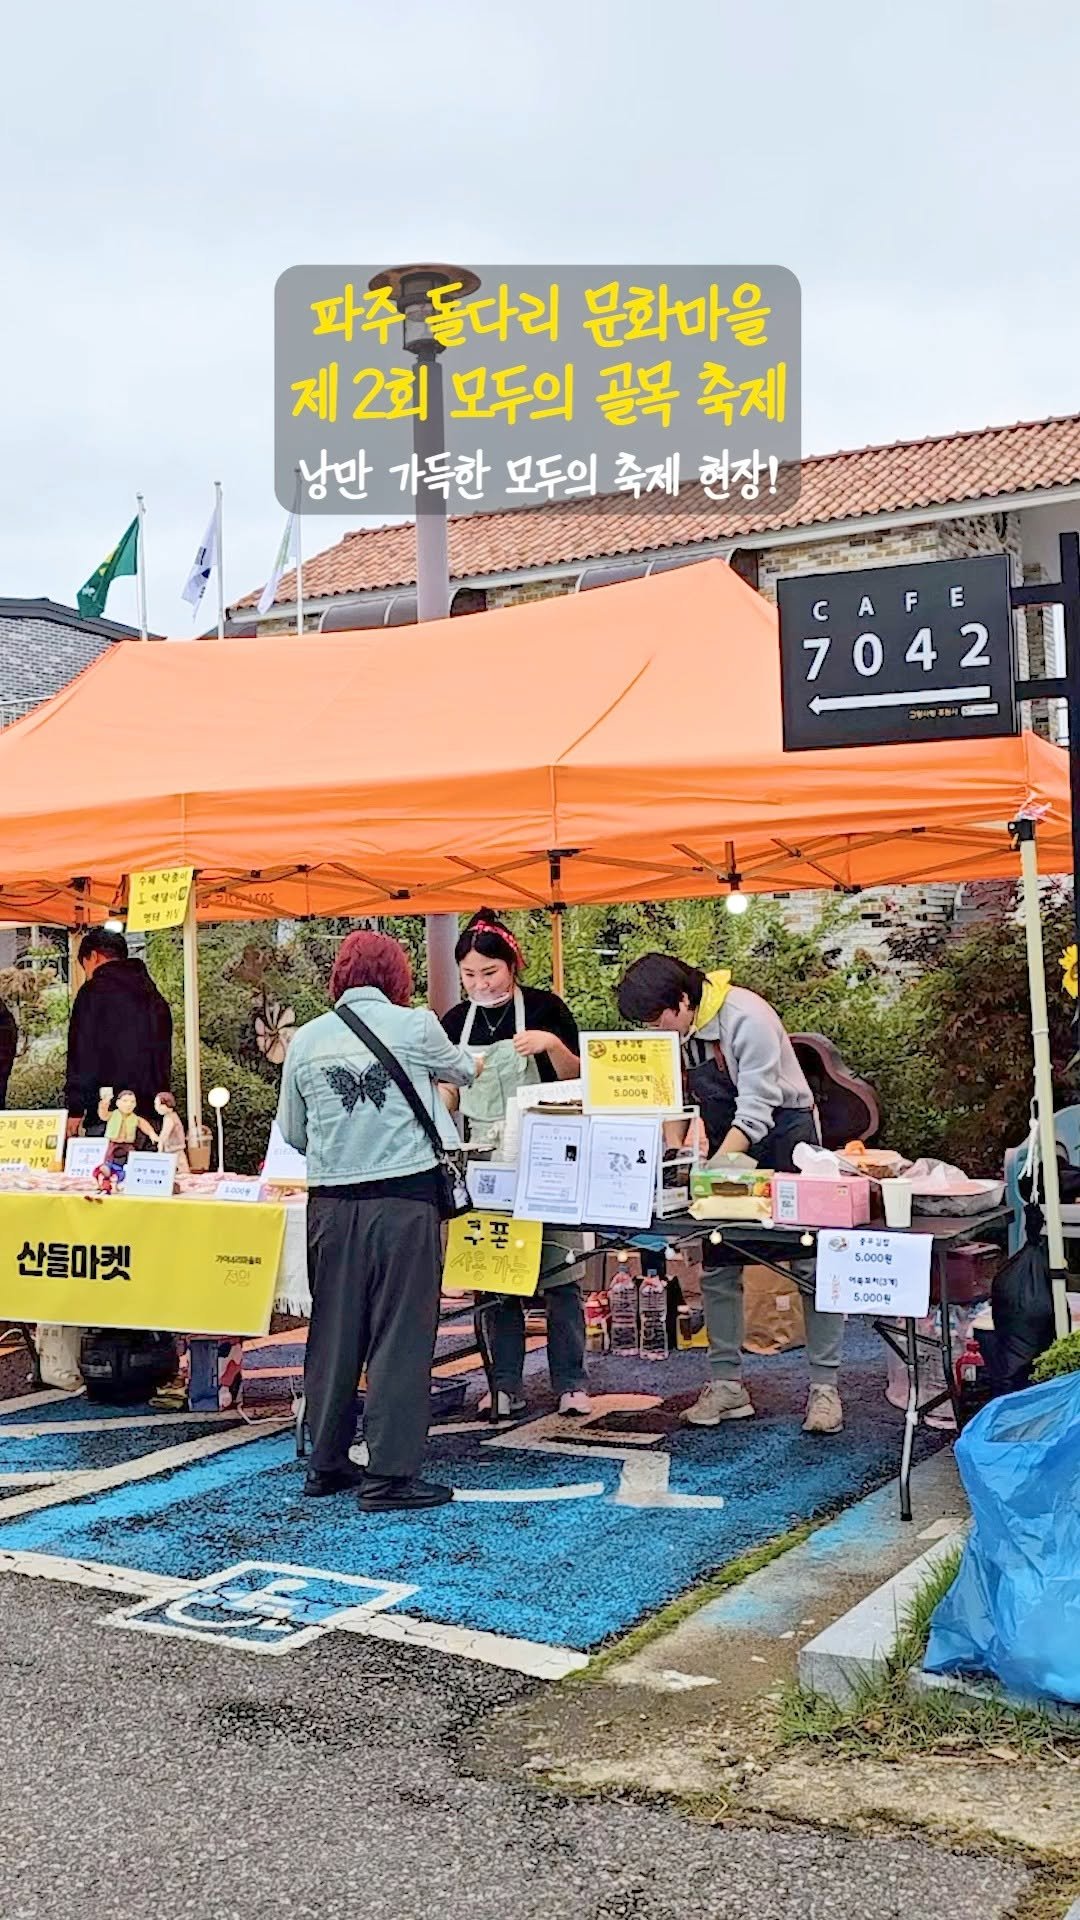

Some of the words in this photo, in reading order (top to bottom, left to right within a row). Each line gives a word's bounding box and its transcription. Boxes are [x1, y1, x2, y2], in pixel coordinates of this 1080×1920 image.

[812, 586, 965, 621] CAFE
[803, 622, 991, 681] 7042
[16, 1241, 132, 1282] 산들마켓
[854, 1252, 892, 1264] 5.000원
[853, 1292, 891, 1305] 5.000원
